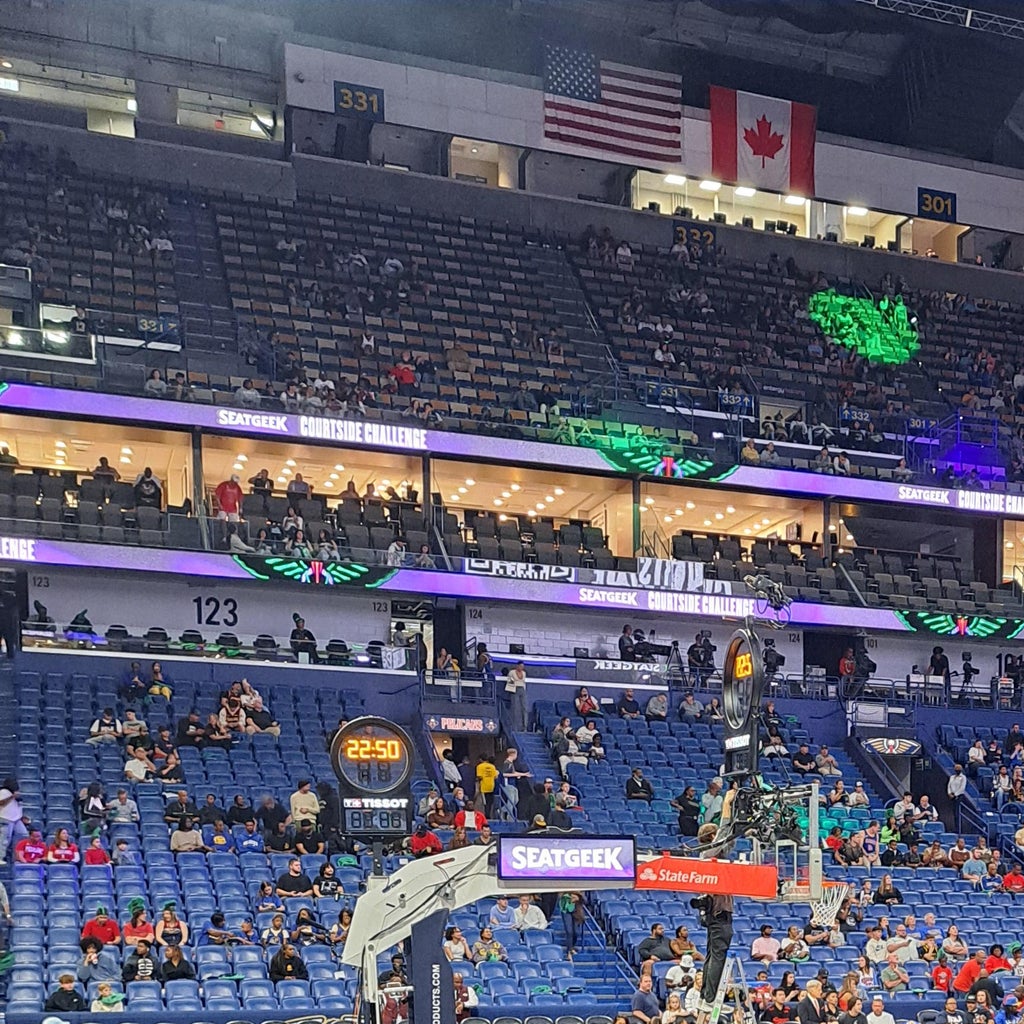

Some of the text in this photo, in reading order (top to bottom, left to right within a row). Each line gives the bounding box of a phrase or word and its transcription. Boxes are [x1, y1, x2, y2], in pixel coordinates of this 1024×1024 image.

[339, 88, 379, 114] 331
[920, 193, 952, 216] 301
[851, 409, 870, 422] 332
[910, 418, 926, 429] 301
[218, 409, 427, 450] SEATGEEK COURTSIDE CHALLENGE
[899, 486, 949, 504] SEATGEEK
[958, 489, 1004, 511] COURTSIDE
[32, 576, 50, 588] 123
[192, 596, 239, 628] 123
[372, 601, 388, 613] 123
[579, 588, 755, 617] SEATGEEK COURTSIDE CHALLENGE
[469, 608, 483, 620] 124
[347, 739, 400, 760] 22:50
[362, 798, 408, 809] TISSOT
[511, 845, 624, 871] SEATGEEK
